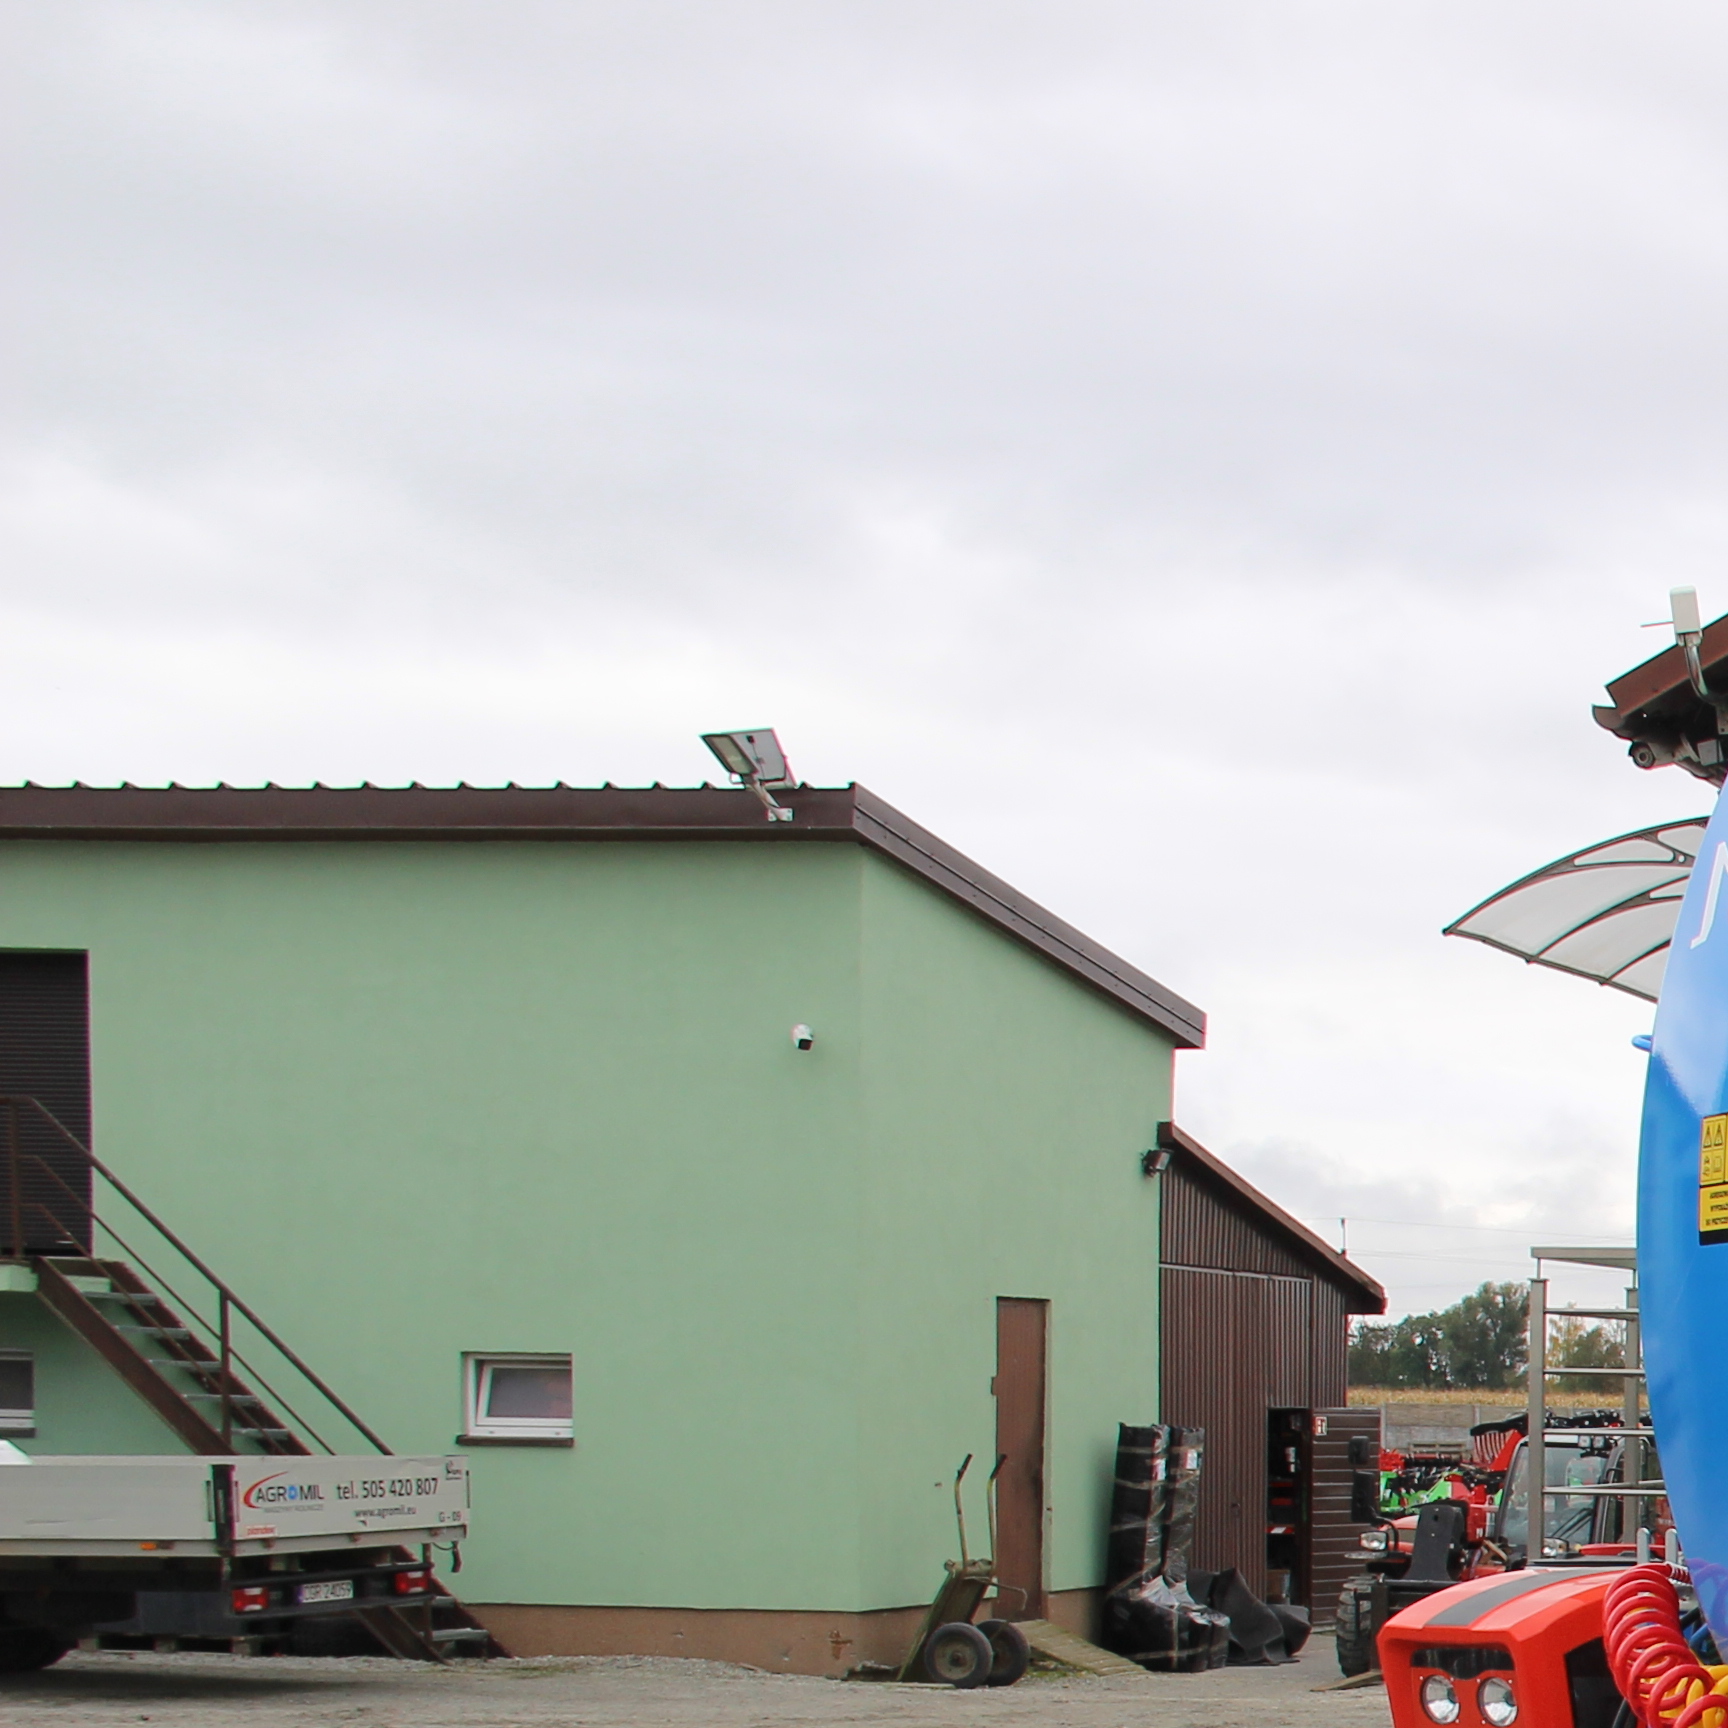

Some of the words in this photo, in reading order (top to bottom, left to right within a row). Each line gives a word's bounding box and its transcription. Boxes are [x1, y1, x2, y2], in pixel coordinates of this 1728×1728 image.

[255, 1483, 325, 1503] AGROMIL
[336, 1480, 359, 1500] tel.
[362, 1480, 386, 1499] 505
[389, 1478, 413, 1497] 420
[416, 1477, 438, 1496] 807
[354, 1504, 417, 1519] www.agromil.eu
